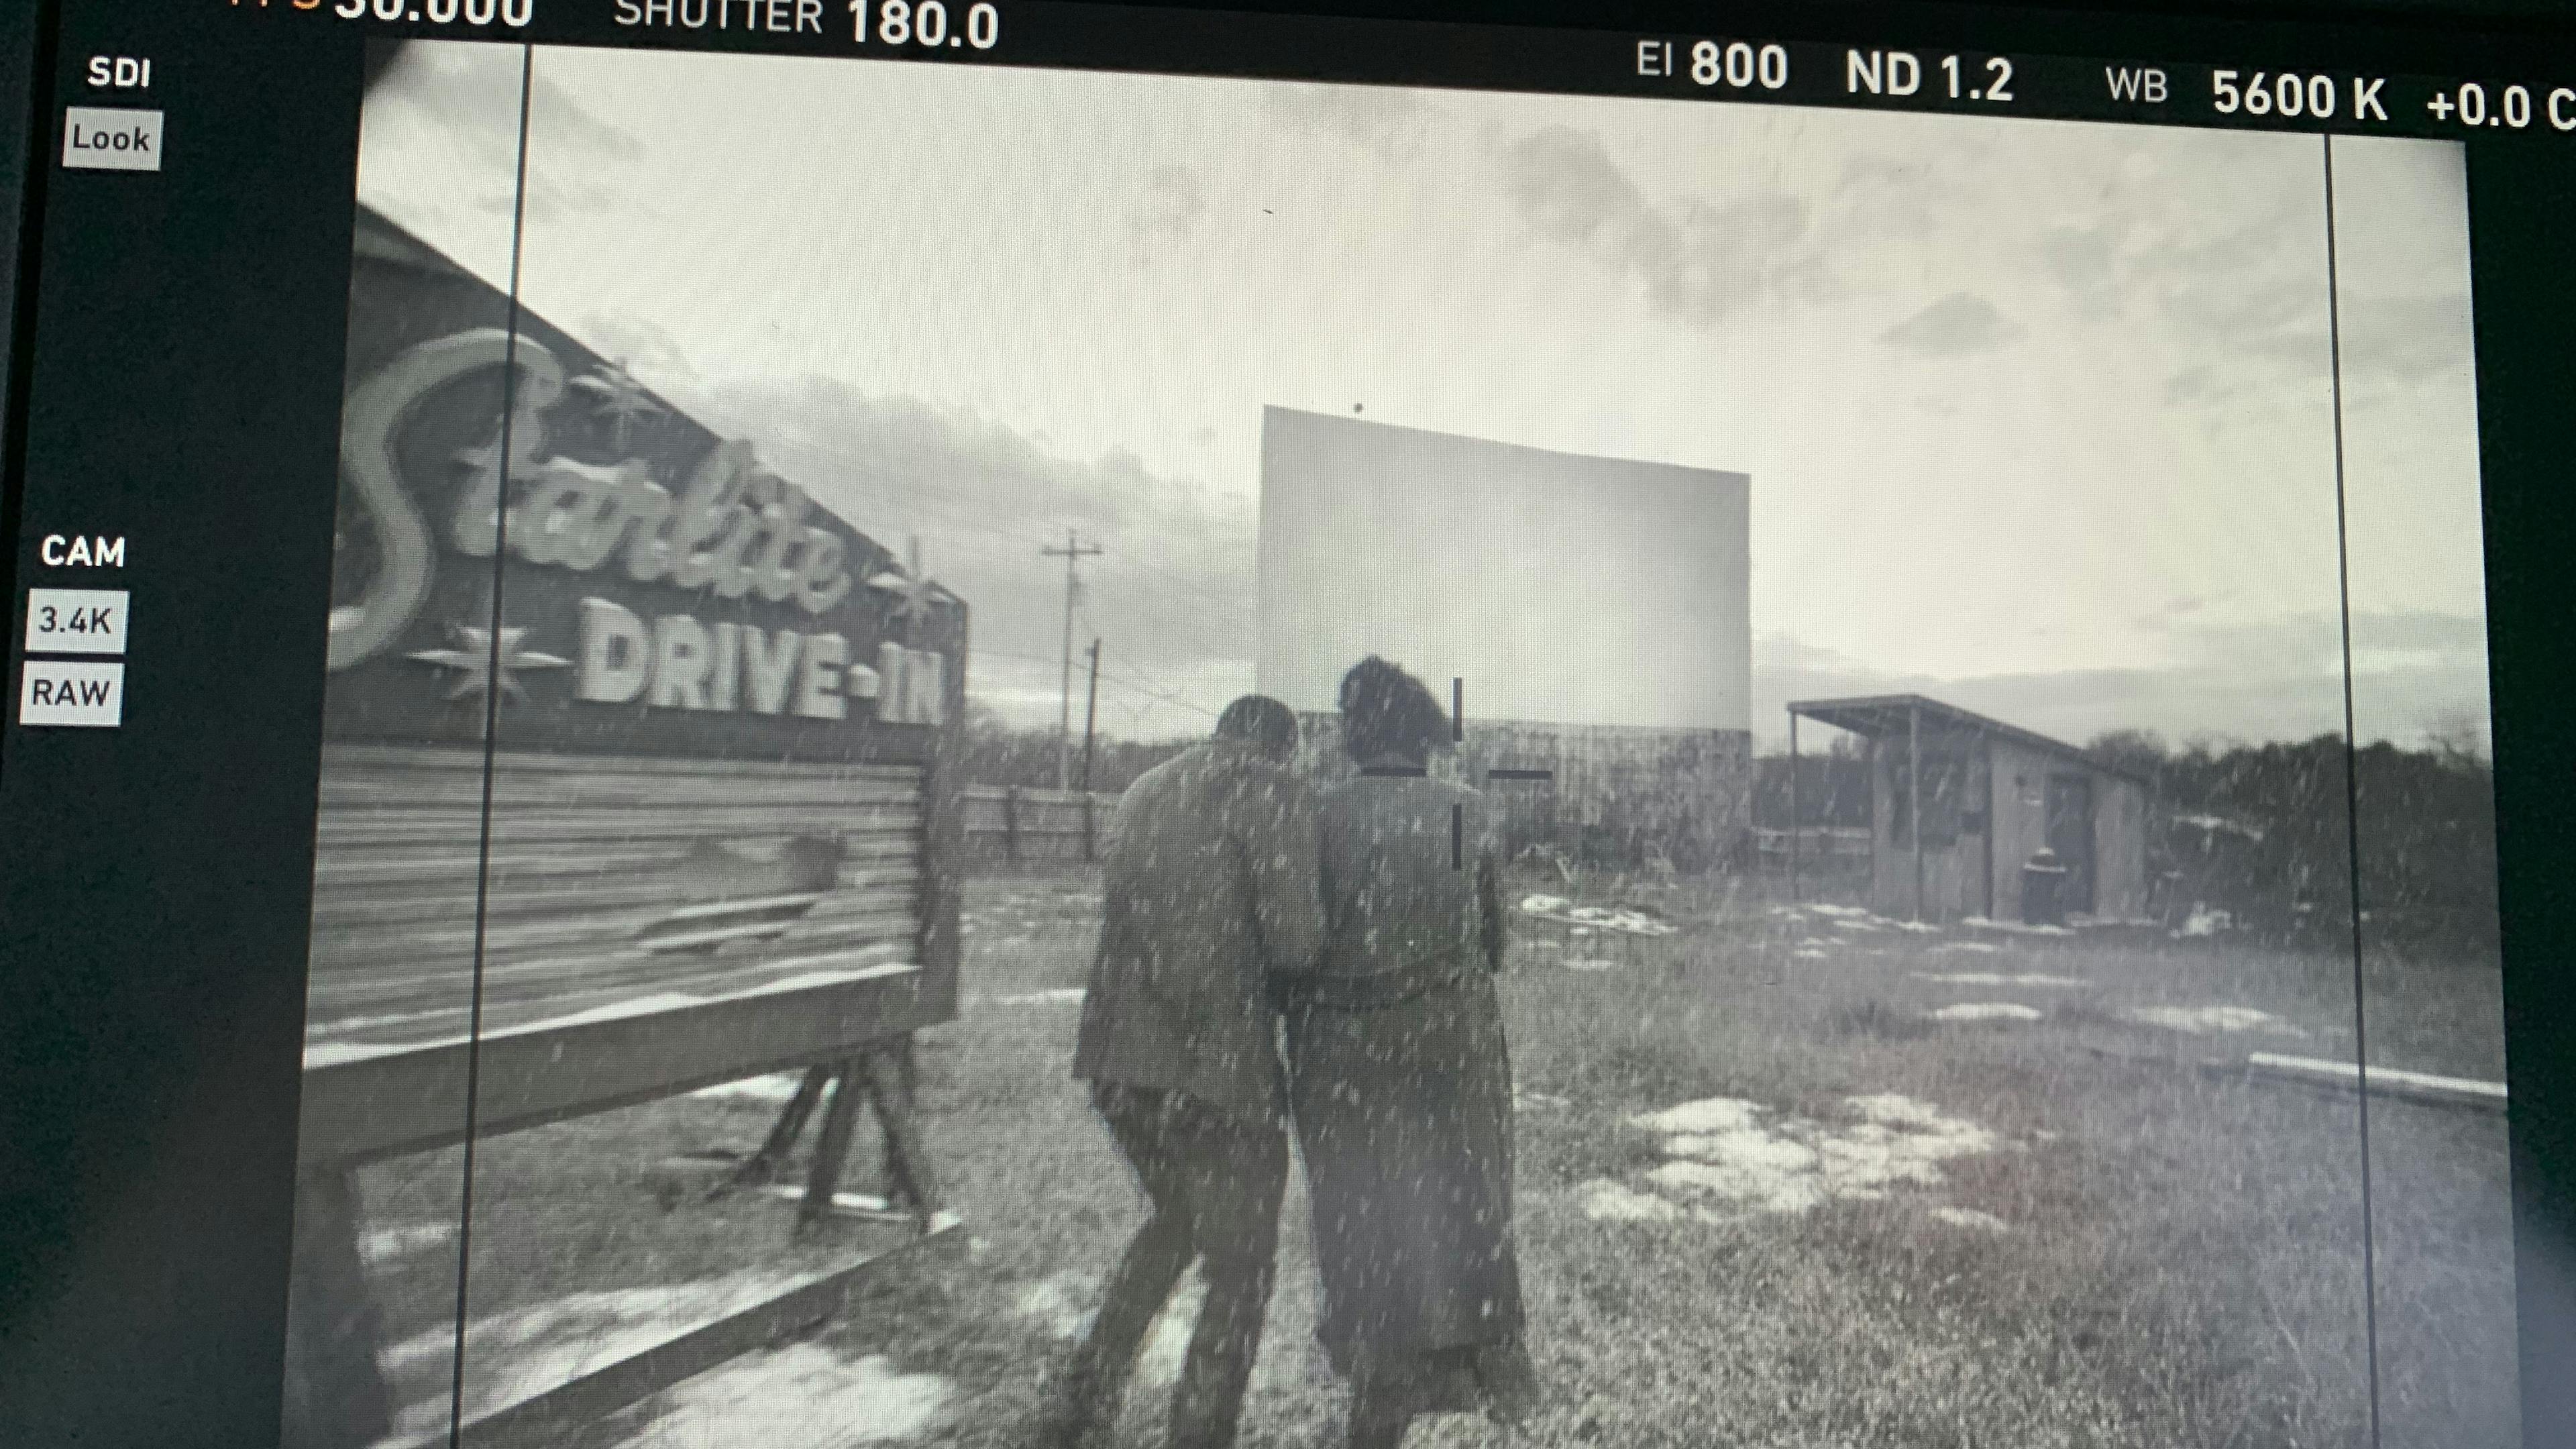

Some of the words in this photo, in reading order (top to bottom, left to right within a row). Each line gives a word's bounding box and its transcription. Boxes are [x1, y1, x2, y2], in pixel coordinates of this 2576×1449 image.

[614, 0, 824, 34] SHUTTER
[848, 0, 1000, 49] 180.0
[87, 56, 151, 88] SDI
[1637, 40, 1672, 76] EI
[1690, 40, 1788, 89] 800
[1847, 49, 1921, 96] ND
[1941, 55, 2013, 101] 1.2
[2104, 66, 2168, 103] WB
[2213, 70, 2336, 118] 5600
[2353, 76, 2389, 121] K
[2426, 83, 2531, 128] +0.0
[72, 122, 151, 152] Look
[327, 327, 852, 673] Starlite
[41, 534, 126, 568] CAM
[39, 606, 113, 635] 3.4K
[577, 594, 944, 725] DRIVE-IN
[32, 679, 110, 707] RAW
